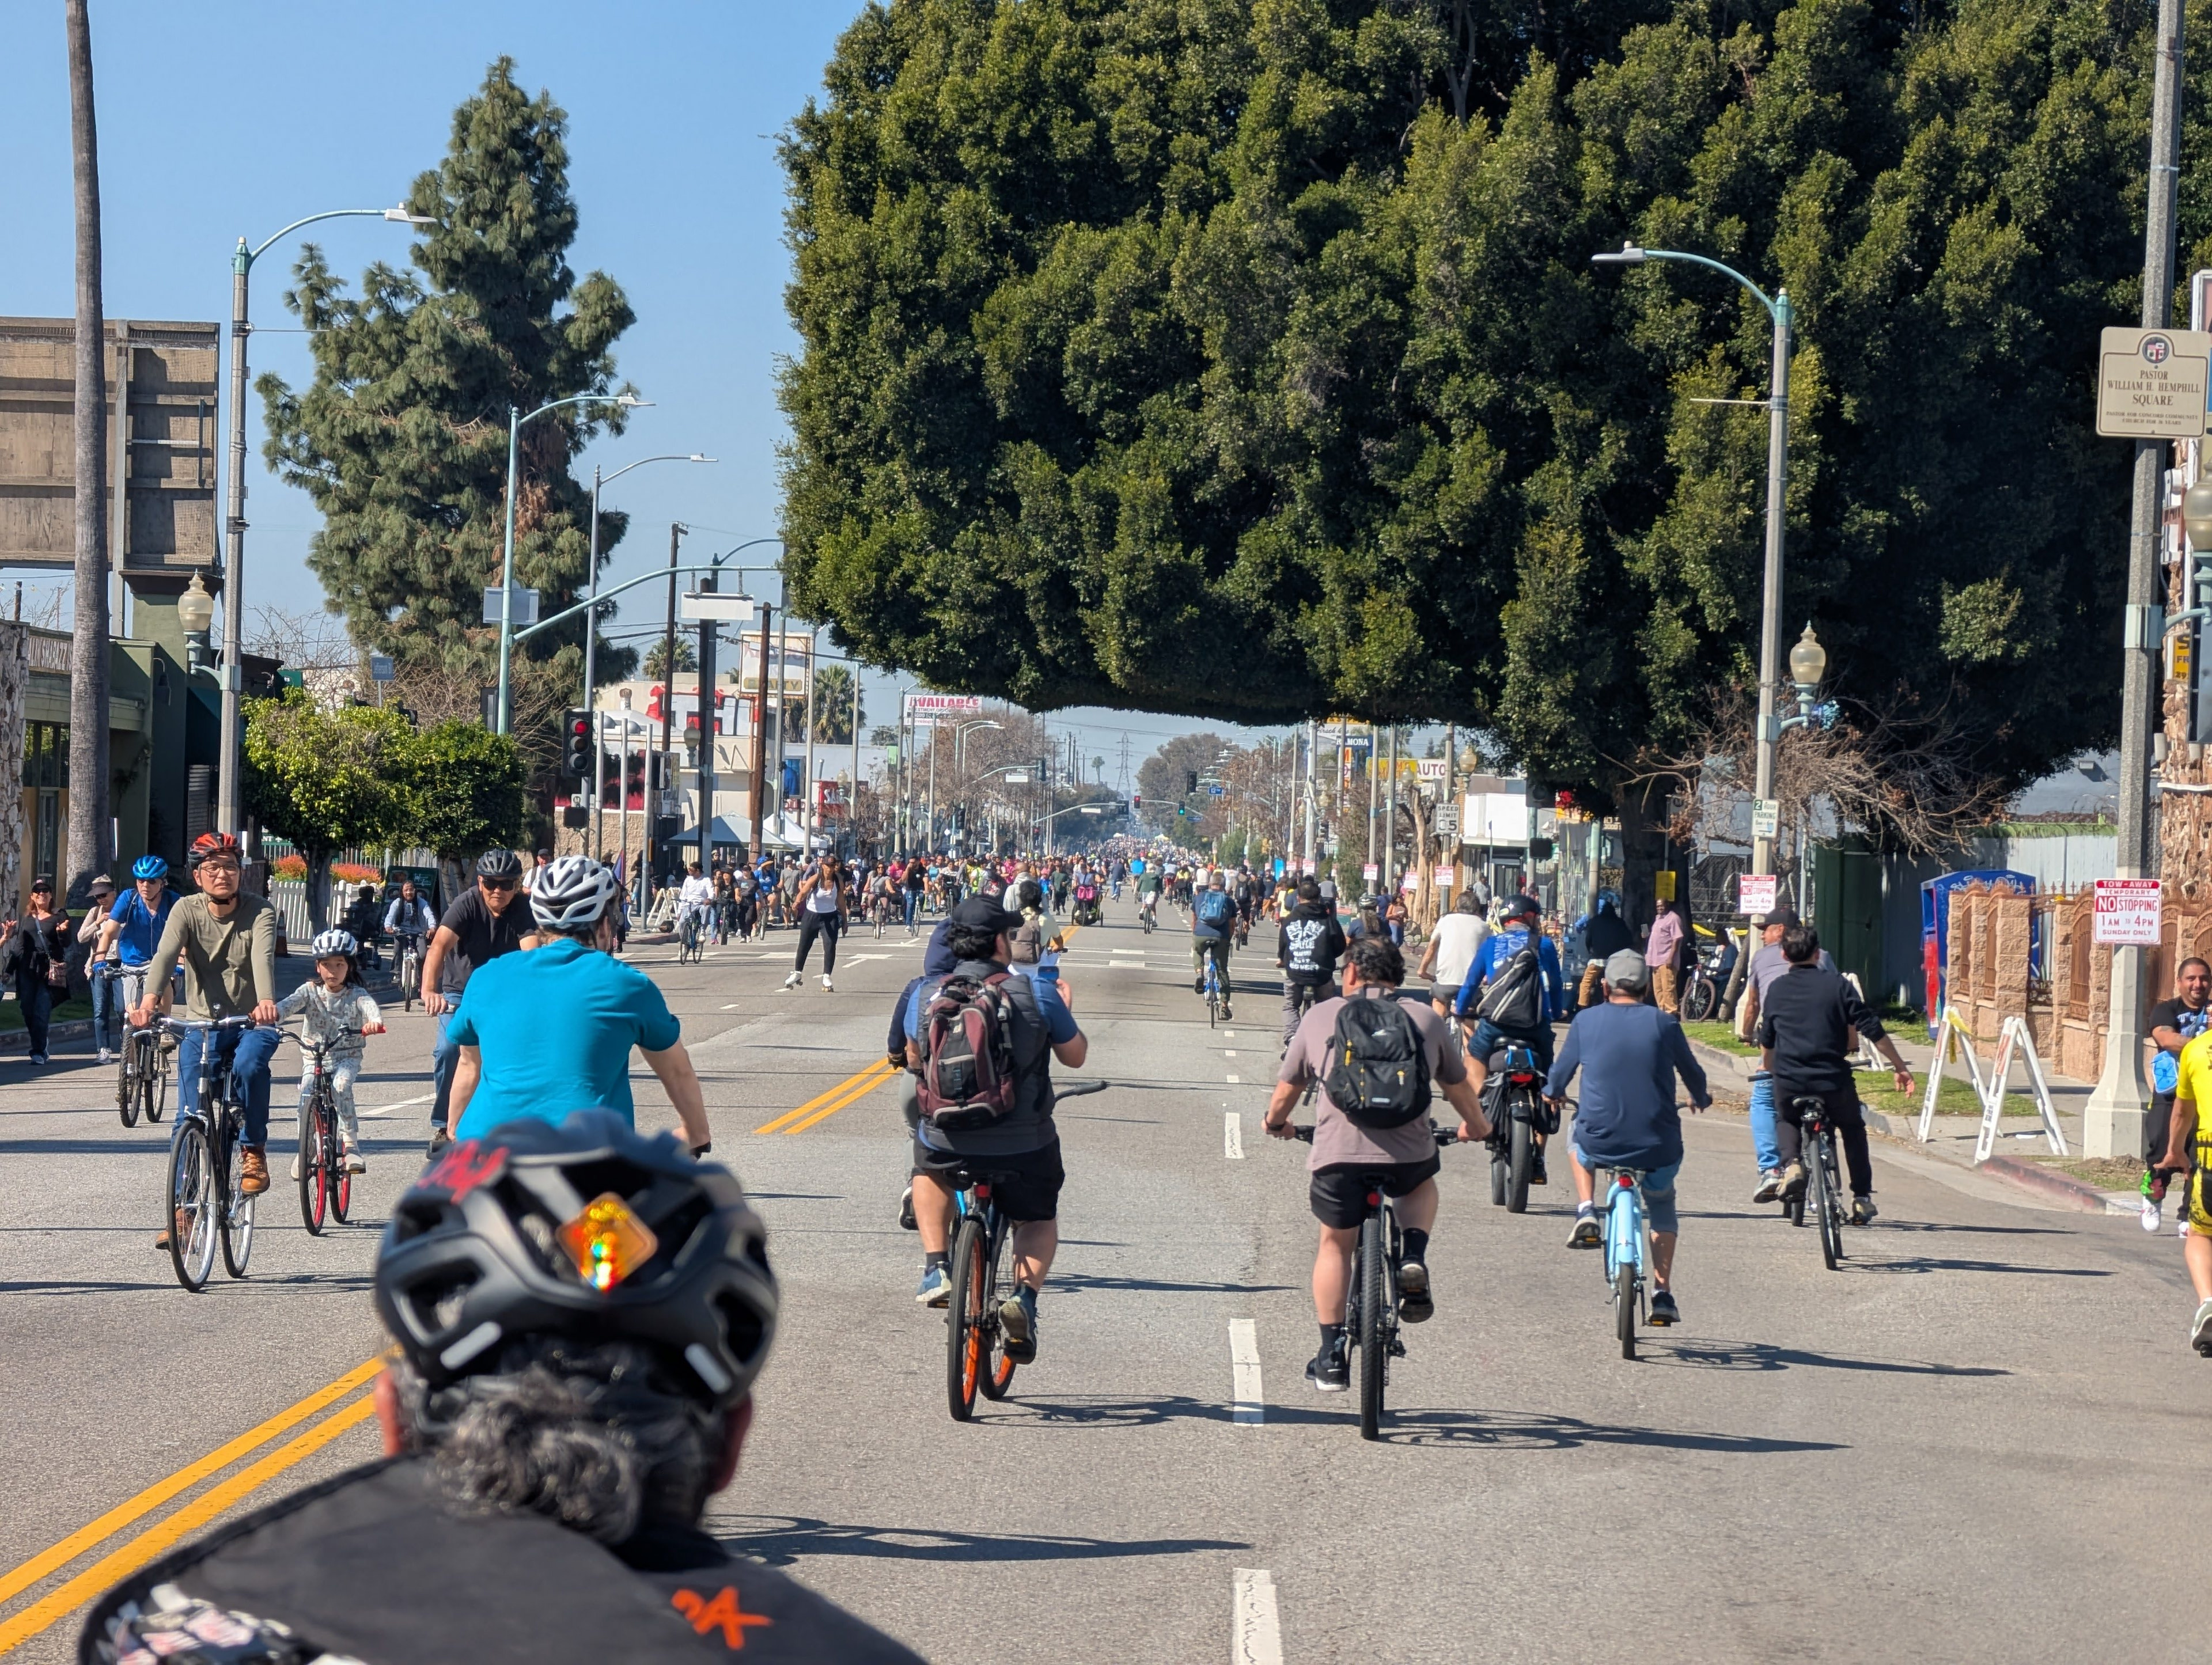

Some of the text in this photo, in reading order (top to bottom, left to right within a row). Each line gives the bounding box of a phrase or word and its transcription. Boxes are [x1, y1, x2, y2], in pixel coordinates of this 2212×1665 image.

[2140, 370, 2168, 380] PASTOR
[2108, 380, 2200, 393] WILLIAM H. HEMPHILL
[2133, 394, 2173, 406] SQUARE
[1336, 738, 1369, 746] RMONA
[1755, 801, 1761, 809] 2
[1755, 811, 1775, 820] PARKING
[2098, 897, 2157, 912] NO STOPPING
